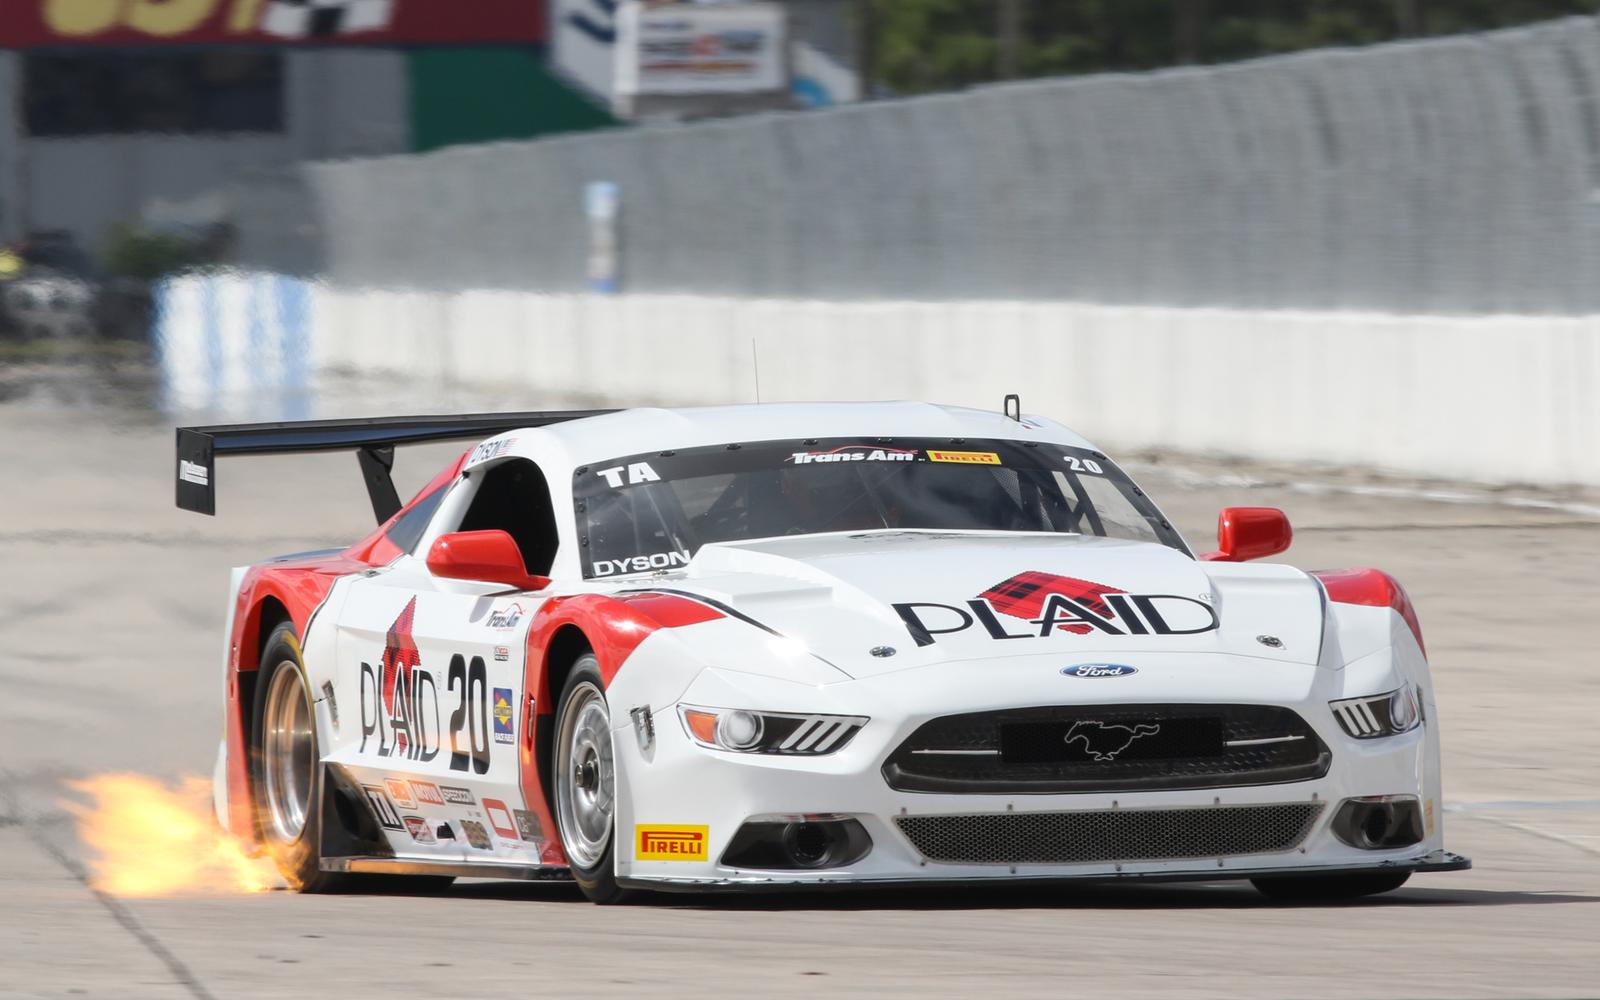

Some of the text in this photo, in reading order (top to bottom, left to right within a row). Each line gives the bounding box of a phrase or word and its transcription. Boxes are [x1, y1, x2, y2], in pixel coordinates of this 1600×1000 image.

[792, 450, 914, 464] Trans Am
[934, 452, 994, 462] PIRELLI
[1063, 456, 1103, 474] 20
[597, 462, 661, 488] TA
[593, 550, 691, 577] DYSON
[891, 594, 1220, 647] PLAID
[1076, 665, 1124, 676] Ford
[360, 661, 441, 762] PLAID
[448, 653, 491, 775] 20
[641, 831, 703, 855] PIRELLI
